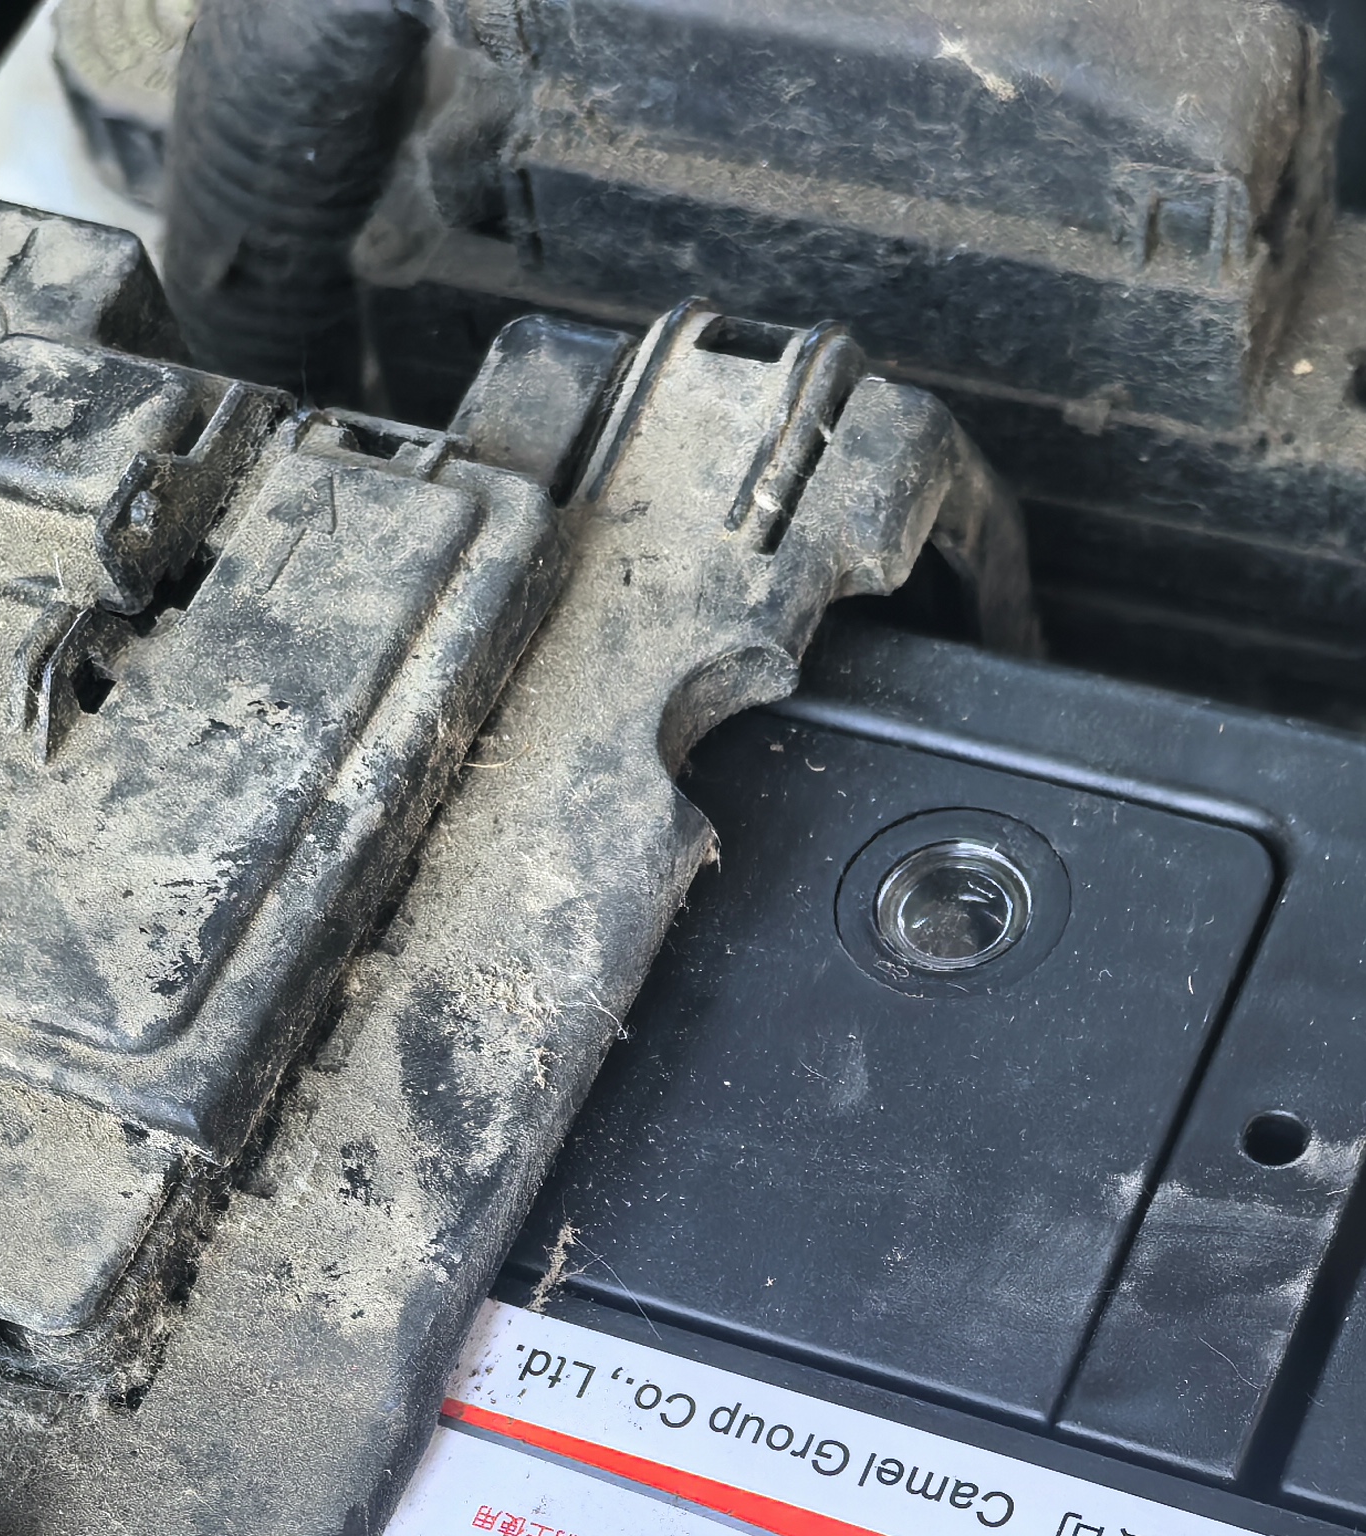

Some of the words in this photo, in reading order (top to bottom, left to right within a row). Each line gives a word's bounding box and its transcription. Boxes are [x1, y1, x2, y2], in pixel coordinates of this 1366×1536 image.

[517, 1344, 596, 1399] Ltd.
[611, 1367, 696, 1429] Co.,
[709, 1402, 850, 1476] Group
[858, 1453, 1015, 1528] Camel
